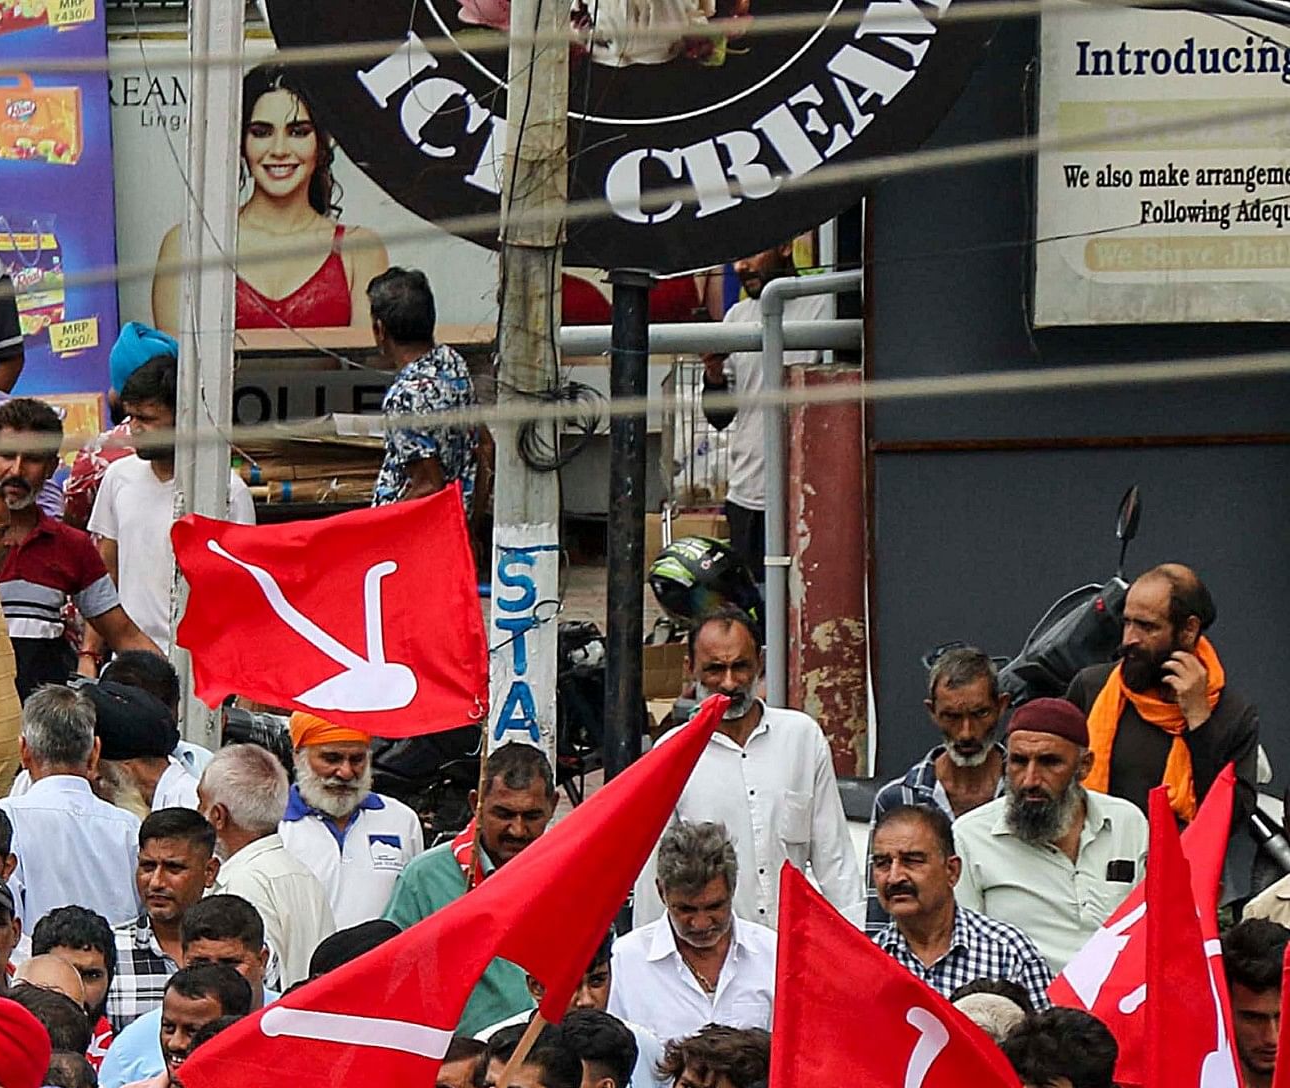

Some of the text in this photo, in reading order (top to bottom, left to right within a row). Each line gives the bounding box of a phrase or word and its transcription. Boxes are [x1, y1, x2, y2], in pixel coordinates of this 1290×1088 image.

[141, 109, 187, 129] Ling
[1063, 164, 1090, 188] We
[1096, 164, 1133, 188] also
[1139, 163, 1190, 187] make
[1140, 199, 1231, 230] Following
[62, 322, 89, 336] MRP
